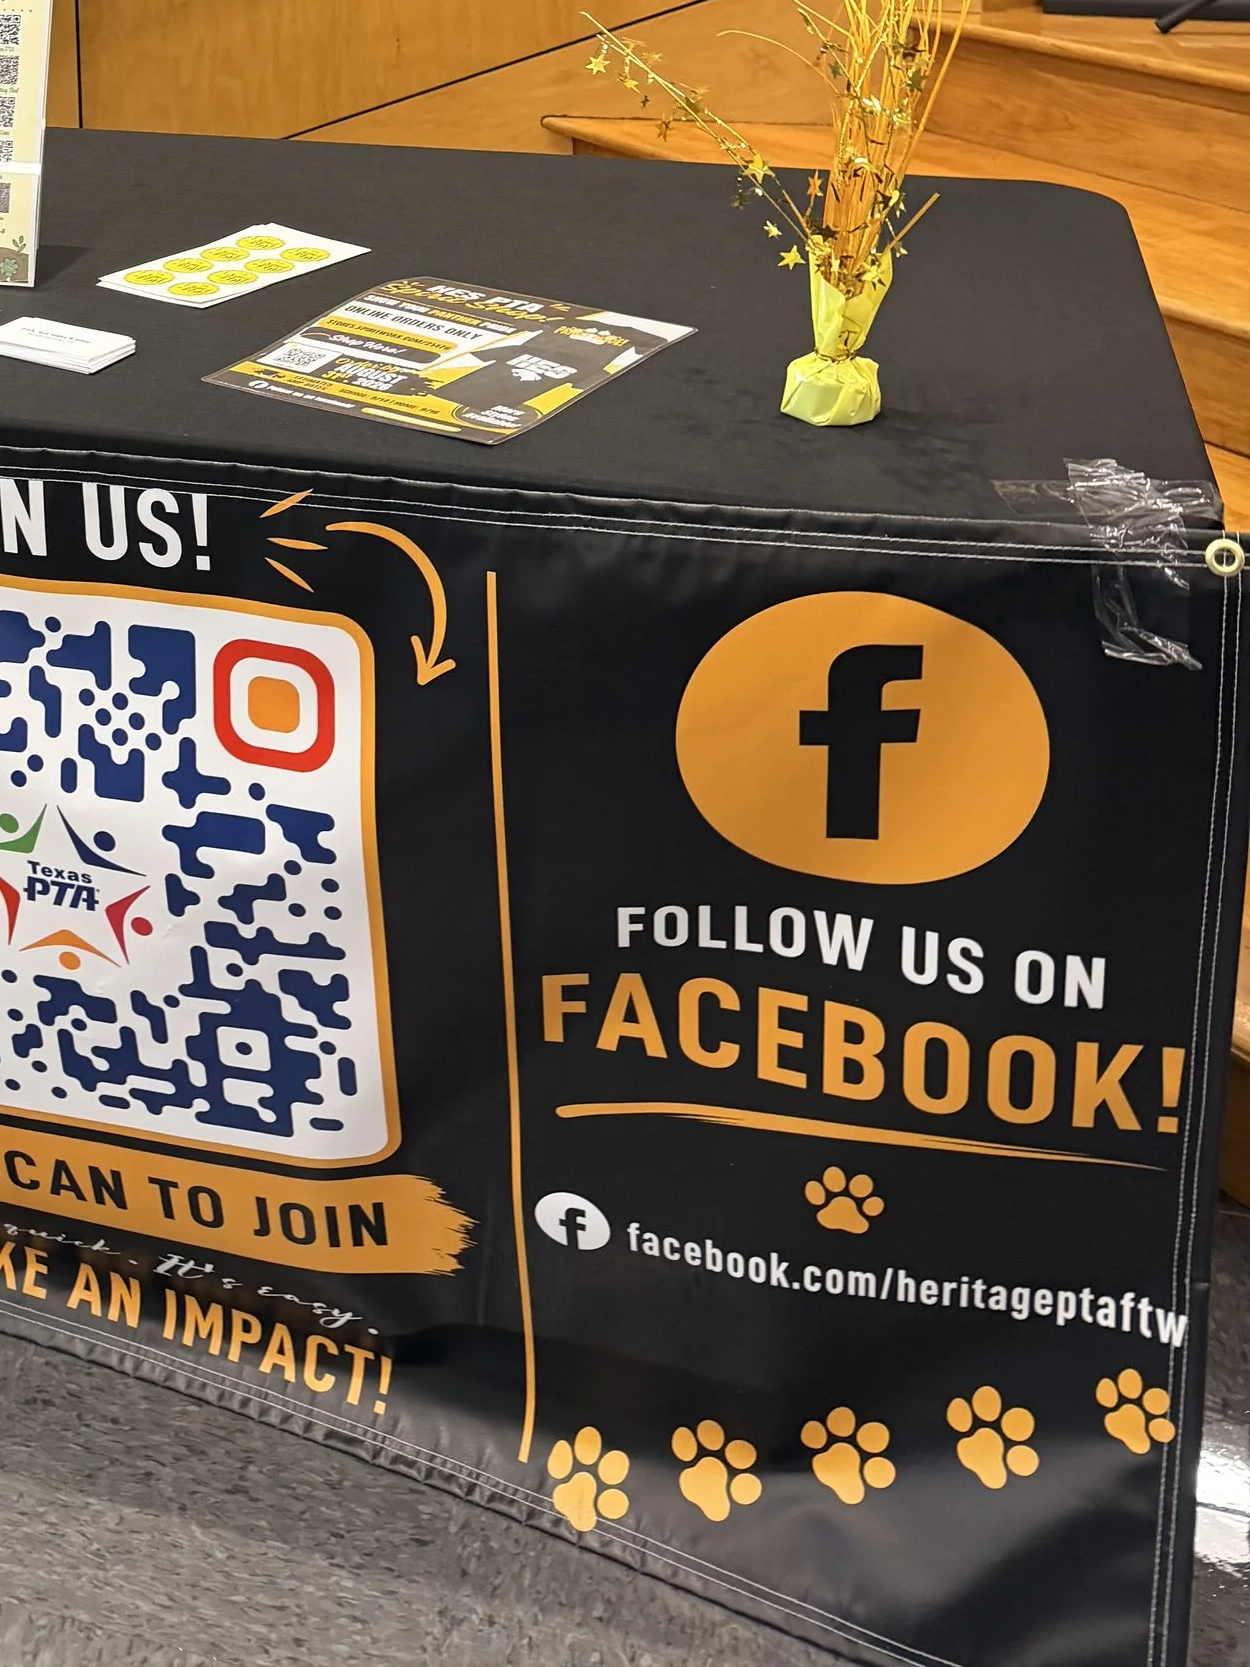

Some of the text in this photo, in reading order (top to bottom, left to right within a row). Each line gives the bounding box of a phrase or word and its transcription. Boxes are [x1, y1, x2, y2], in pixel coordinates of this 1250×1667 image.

[344, 305, 484, 341] ONLINE ORDERS ONLY
[363, 294, 399, 307] SHOW
[426, 284, 545, 313] HES PTA
[328, 334, 363, 349] Shop
[333, 363, 408, 384] AUGUST
[79, 483, 213, 571] US!
[23, 876, 100, 911] PTA
[27, 860, 92, 884] Texas
[616, 905, 1107, 1010] FOLLOW US ON
[541, 971, 1187, 1134] FACEBOOK!
[147, 1175, 228, 1231] TO
[252, 1198, 387, 1251] JOIN
[153, 1253, 243, 1289] It's
[257, 1286, 380, 1335] easy.
[627, 1221, 1188, 1347] facebook.com/heritageptaftw
[66, 1262, 141, 1331] AN
[162, 1288, 393, 1415] IMPACT!
